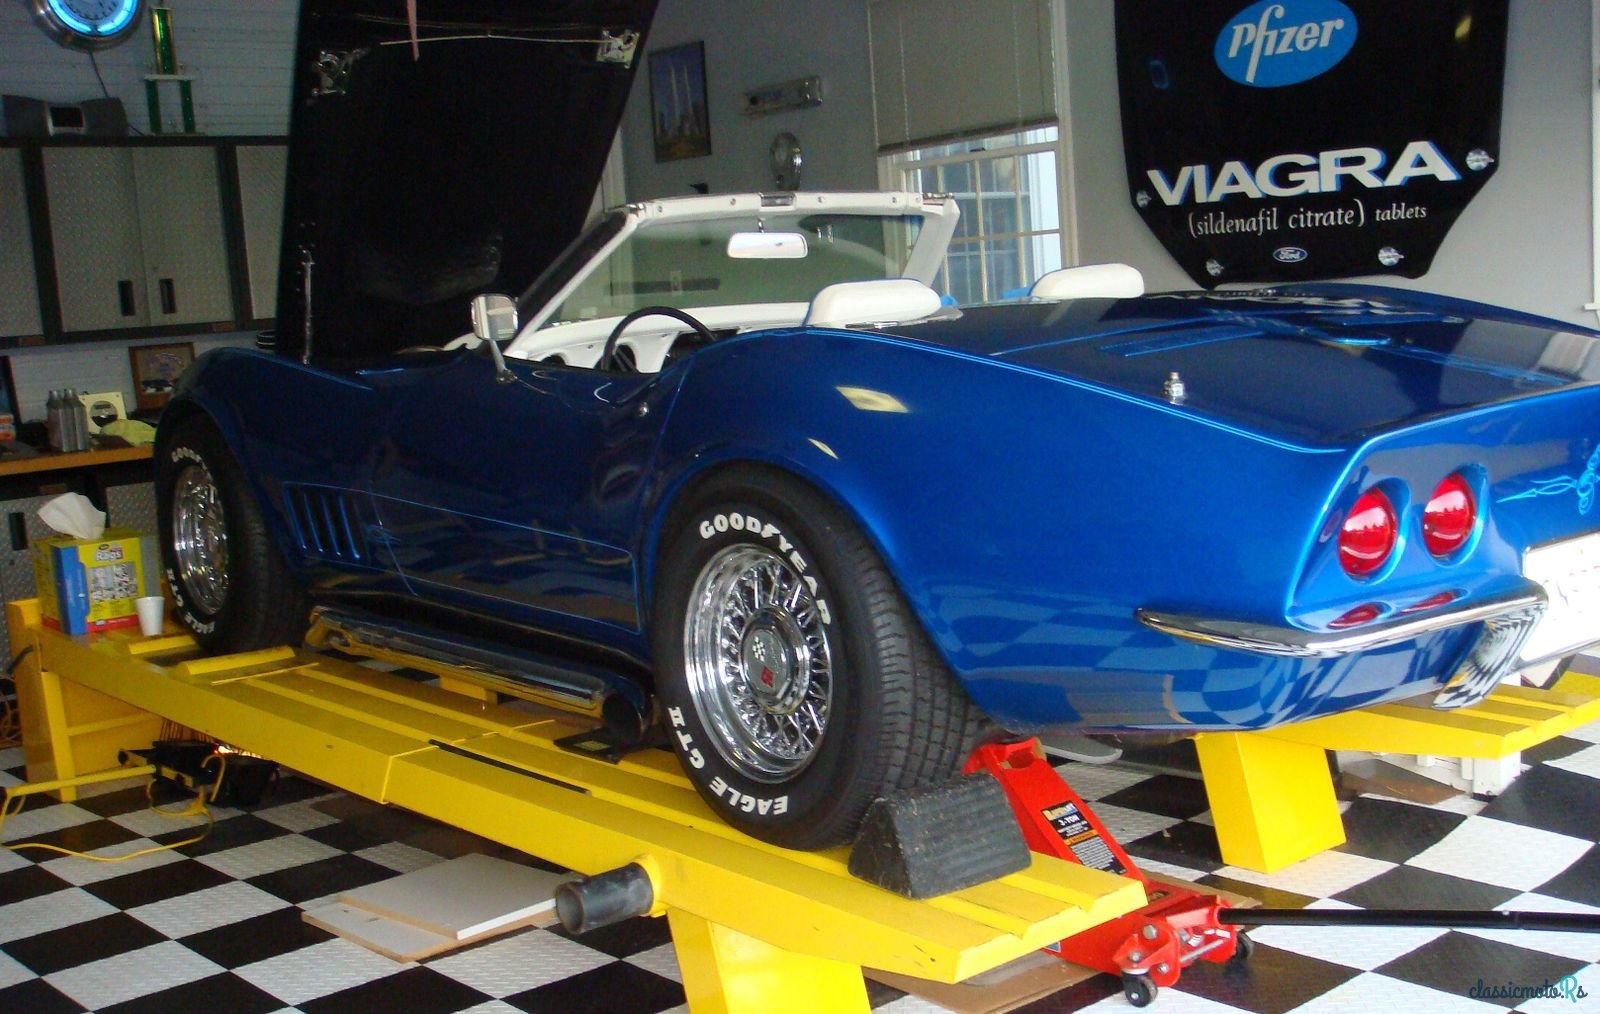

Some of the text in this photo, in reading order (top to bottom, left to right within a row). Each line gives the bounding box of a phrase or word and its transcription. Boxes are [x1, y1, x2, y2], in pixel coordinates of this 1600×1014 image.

[1228, 4, 1345, 83] Pfizer
[1147, 141, 1461, 207] VIAGRA
[1189, 199, 1427, 238] (sildenafil citrate) tablets
[676, 729, 705, 769] GT
[708, 775, 789, 817] EAGLE
